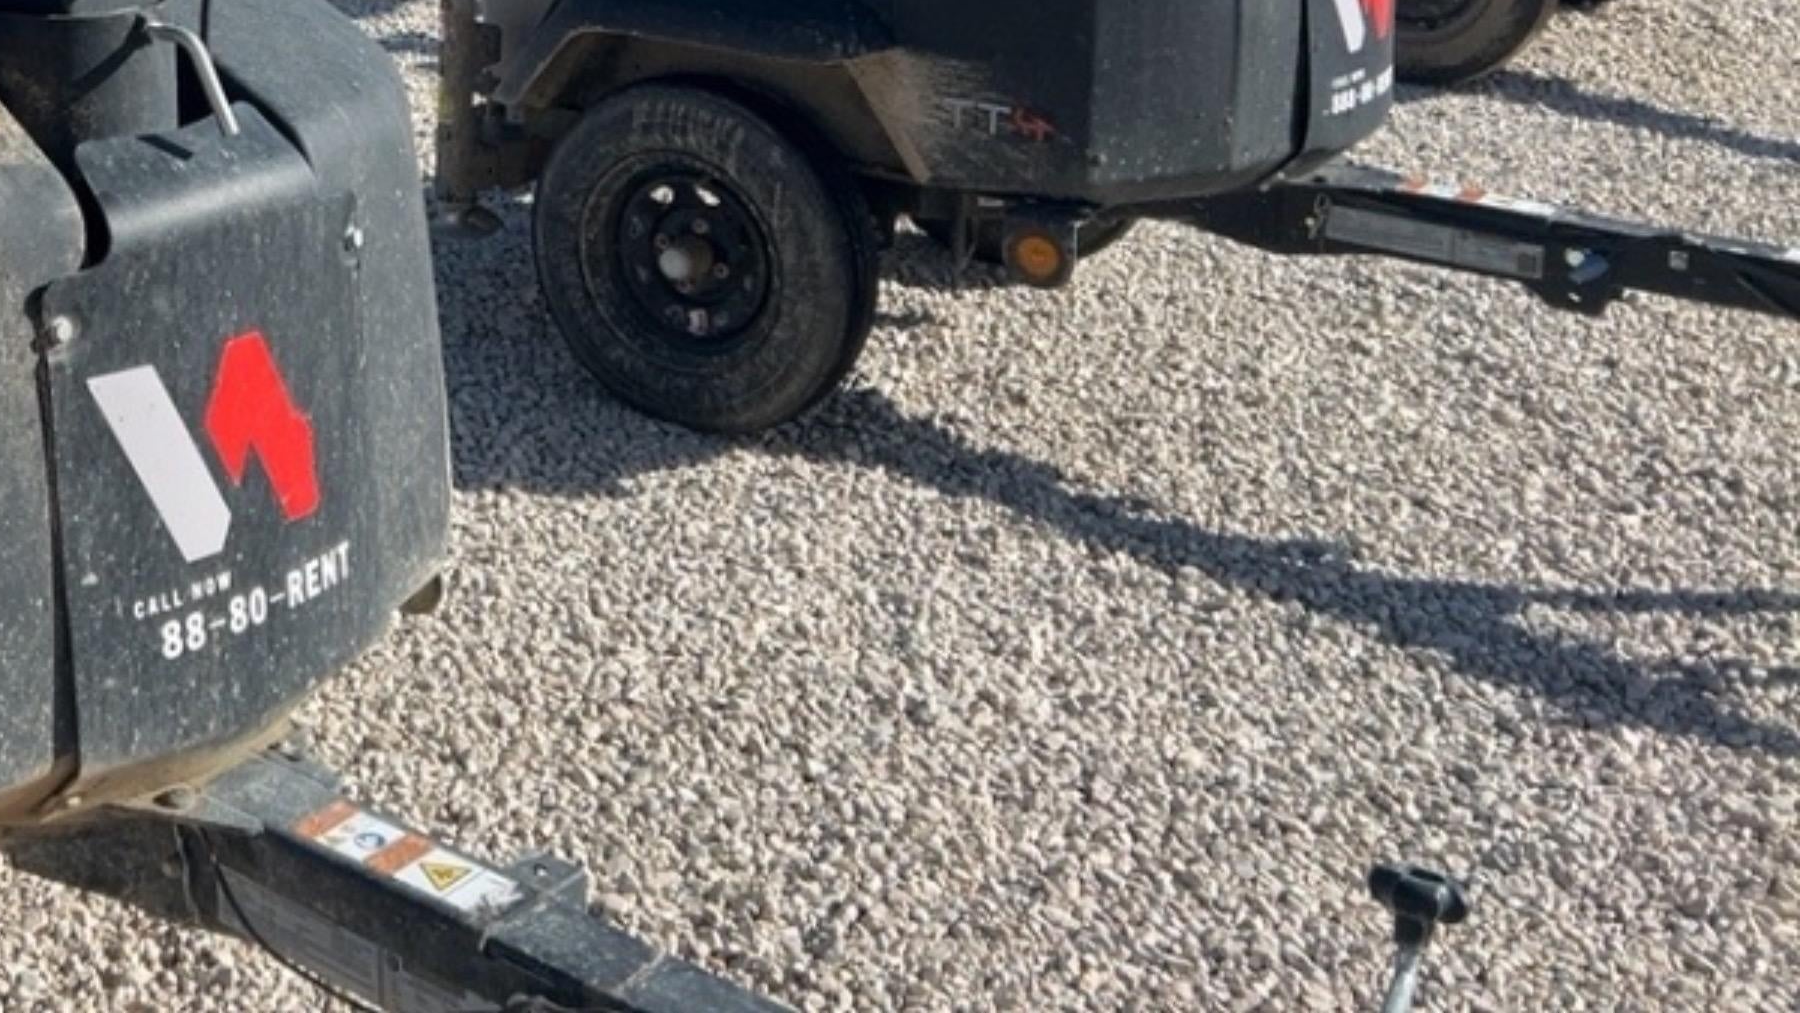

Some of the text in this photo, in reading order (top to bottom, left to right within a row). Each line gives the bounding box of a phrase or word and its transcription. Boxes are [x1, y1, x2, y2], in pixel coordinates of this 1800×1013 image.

[133, 569, 233, 620] CALL NOW
[160, 540, 350, 661] 88-80-RENT
